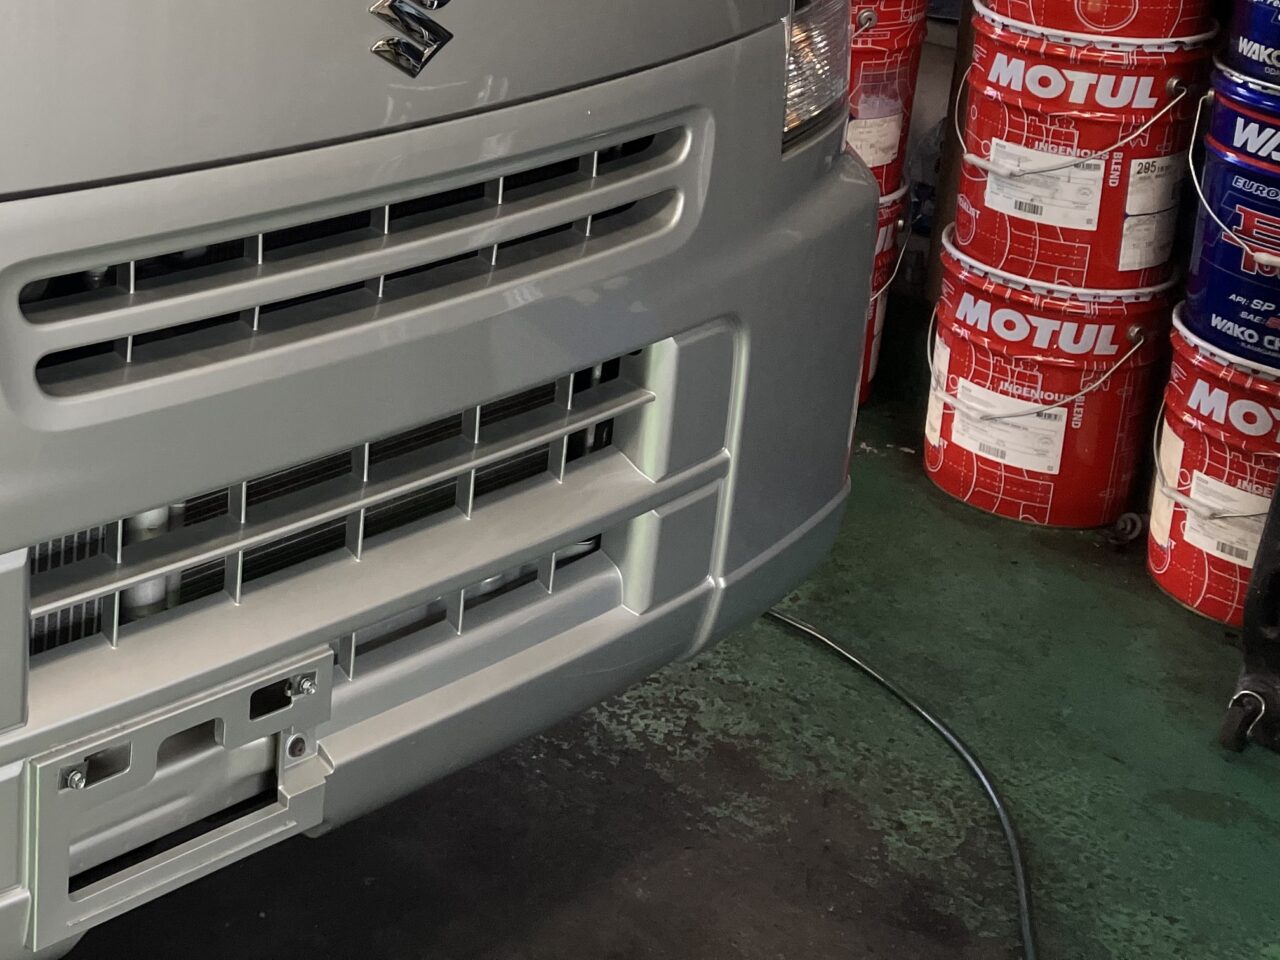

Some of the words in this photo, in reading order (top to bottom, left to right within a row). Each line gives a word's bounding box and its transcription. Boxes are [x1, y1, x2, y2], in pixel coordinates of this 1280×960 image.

[987, 52, 1160, 109] MOTUL
[1034, 140, 1110, 161] INGENIOUS
[1109, 151, 1123, 188] BLEND
[1250, 299, 1276, 311] SP
[955, 292, 1121, 355] MOTUL
[1211, 313, 1260, 344] WAKO
[1072, 394, 1086, 429] BLEND
